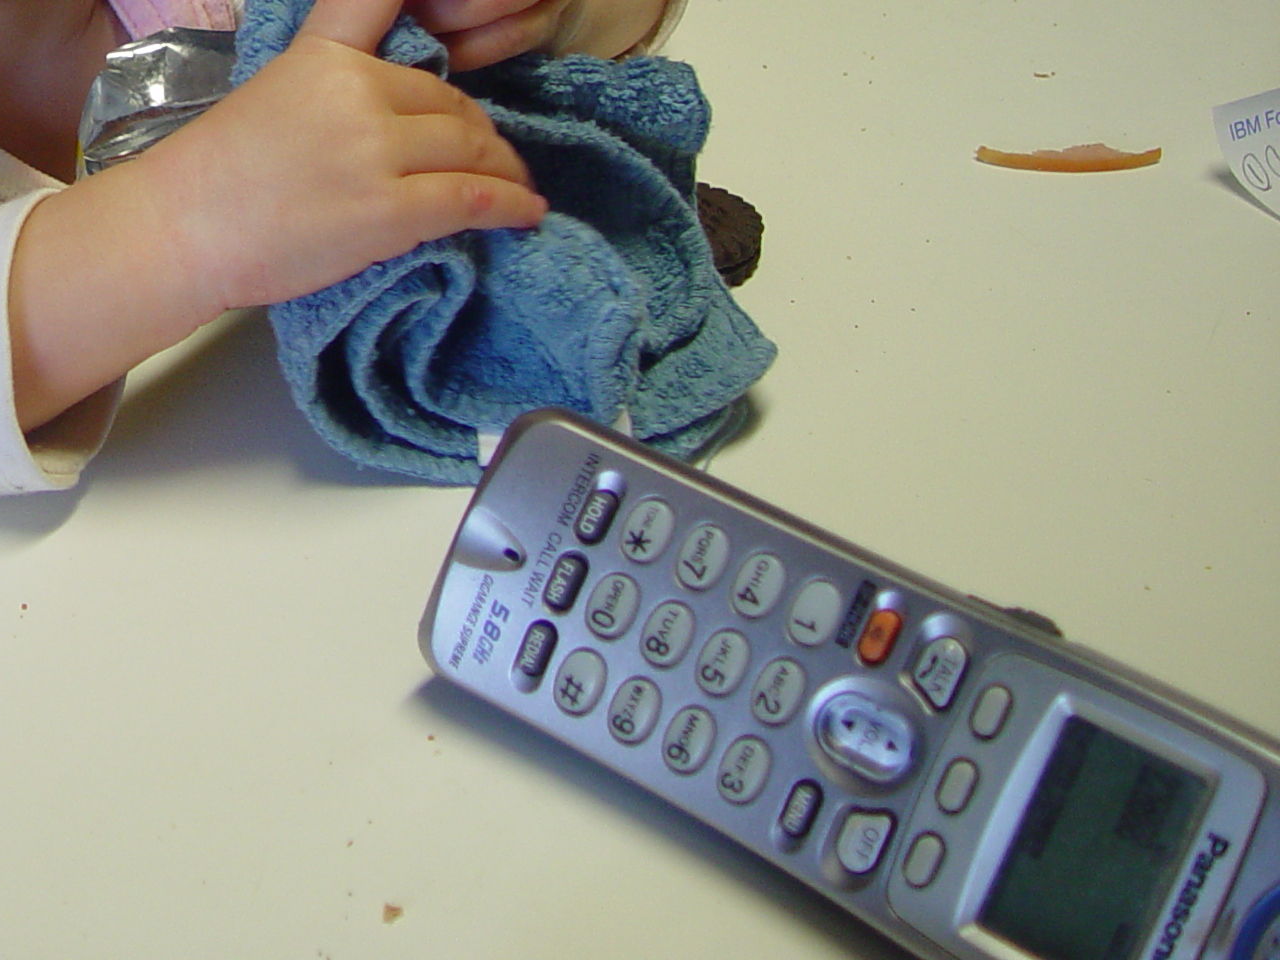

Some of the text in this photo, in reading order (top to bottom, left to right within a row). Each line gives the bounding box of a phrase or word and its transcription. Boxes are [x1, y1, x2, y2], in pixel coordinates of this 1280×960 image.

[1229, 115, 1262, 141] IBM
[557, 453, 601, 526] INTERCOM
[580, 496, 608, 534] HOLD
[521, 532, 562, 608] CALL WAIT
[546, 561, 574, 603] FLASH
[683, 560, 707, 580] 7
[738, 587, 759, 606] 4
[449, 574, 494, 670] GIGARANGE SUPREME
[592, 609, 615, 628] 0
[646, 610, 679, 656] TUV 8
[794, 619, 817, 632] 1
[521, 628, 546, 668] REDIAL
[701, 664, 725, 685] 5
[929, 657, 957, 693] TALK
[755, 692, 780, 715] 2
[612, 714, 635, 735] 9
[667, 743, 690, 764] 6
[721, 772, 744, 793] 3
[785, 786, 812, 831] MENU
[856, 827, 880, 859] OFF
[1152, 832, 1230, 960] Panason
